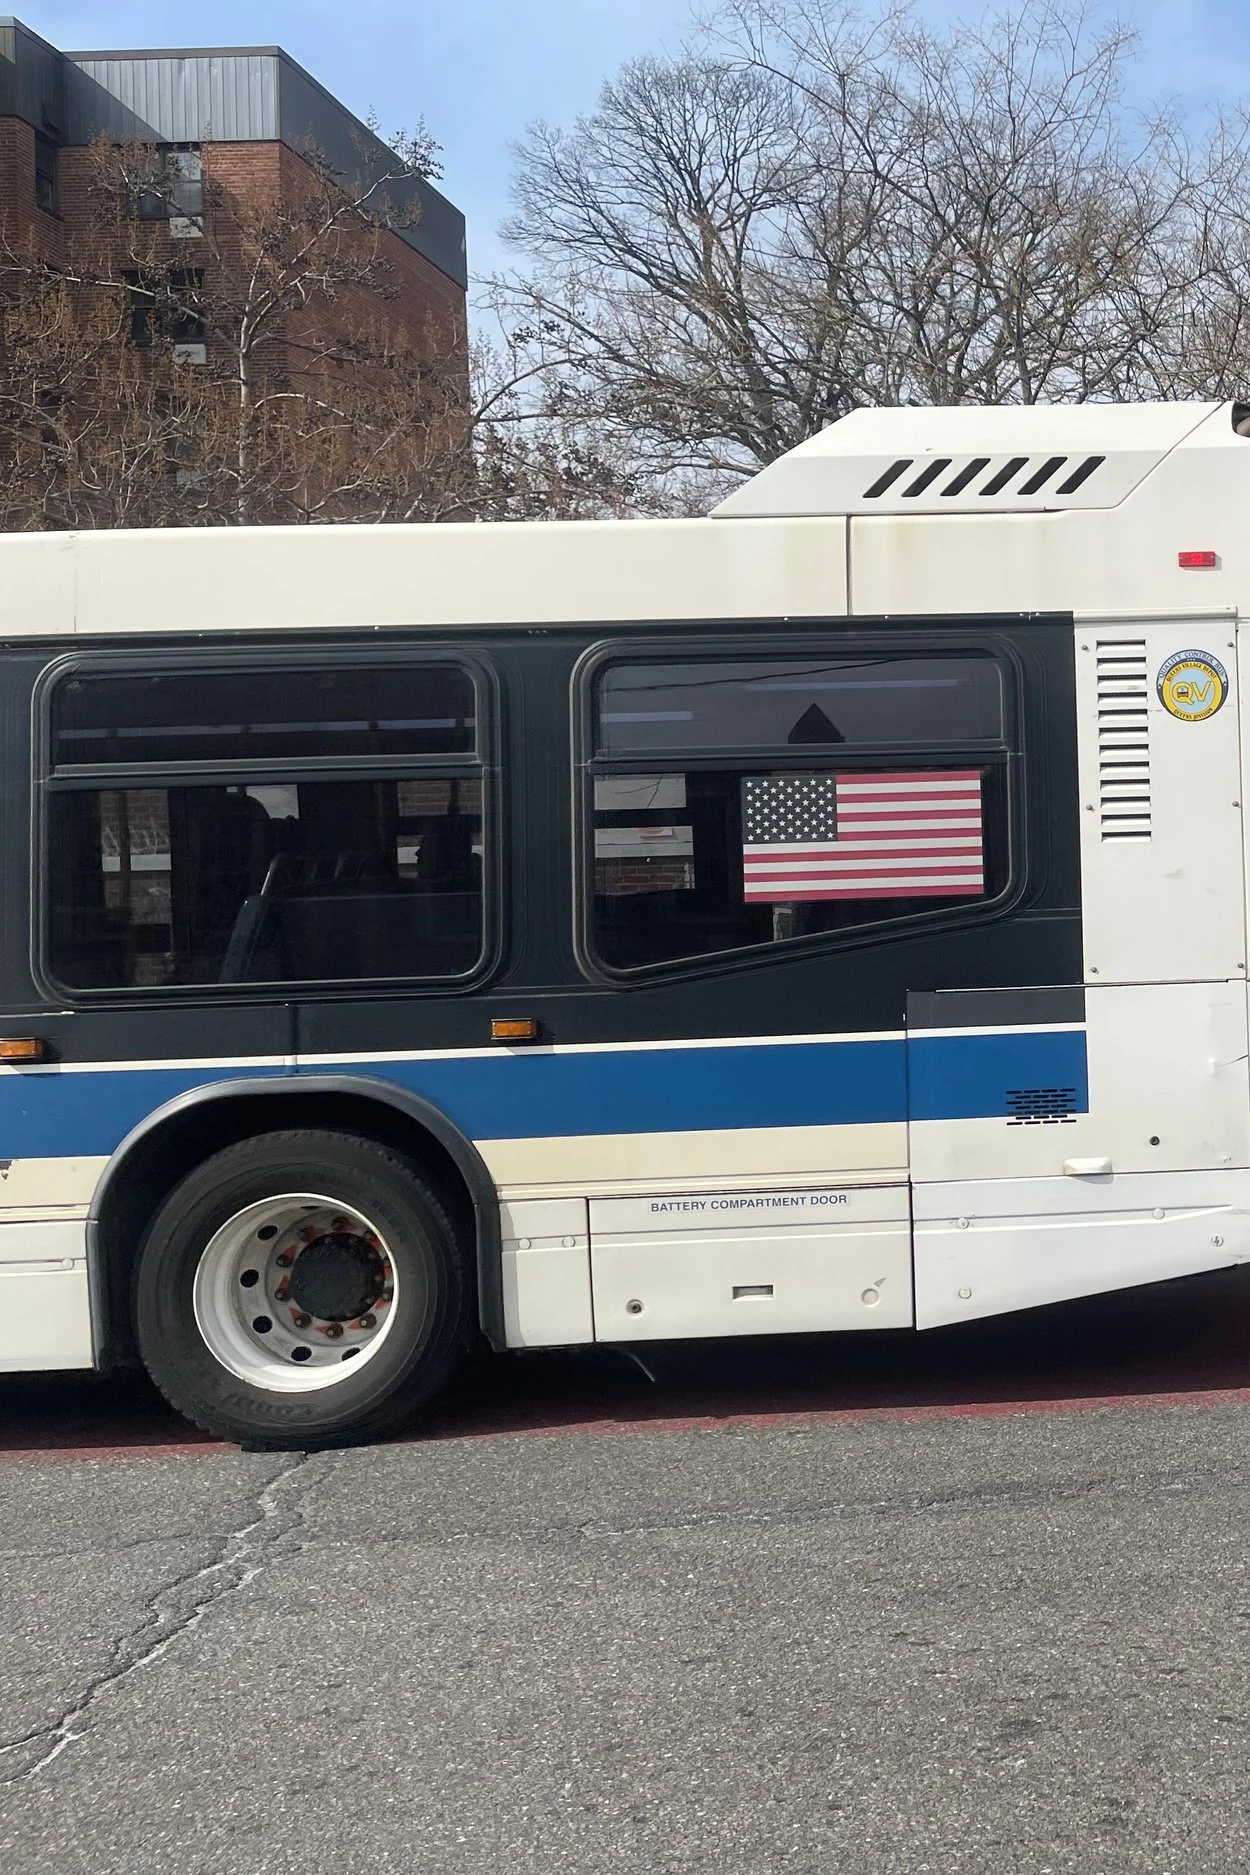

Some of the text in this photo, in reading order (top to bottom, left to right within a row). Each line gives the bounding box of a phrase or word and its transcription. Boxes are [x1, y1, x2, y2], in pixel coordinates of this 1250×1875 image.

[1159, 651, 1225, 678] QUALITY CONTROL BUS
[1166, 666, 1182, 682] QUEENS
[1202, 664, 1218, 679] DEPOT
[1172, 682, 1211, 705] QV
[650, 1194, 848, 1212] BATTERY COMPARTMENT DOOR
